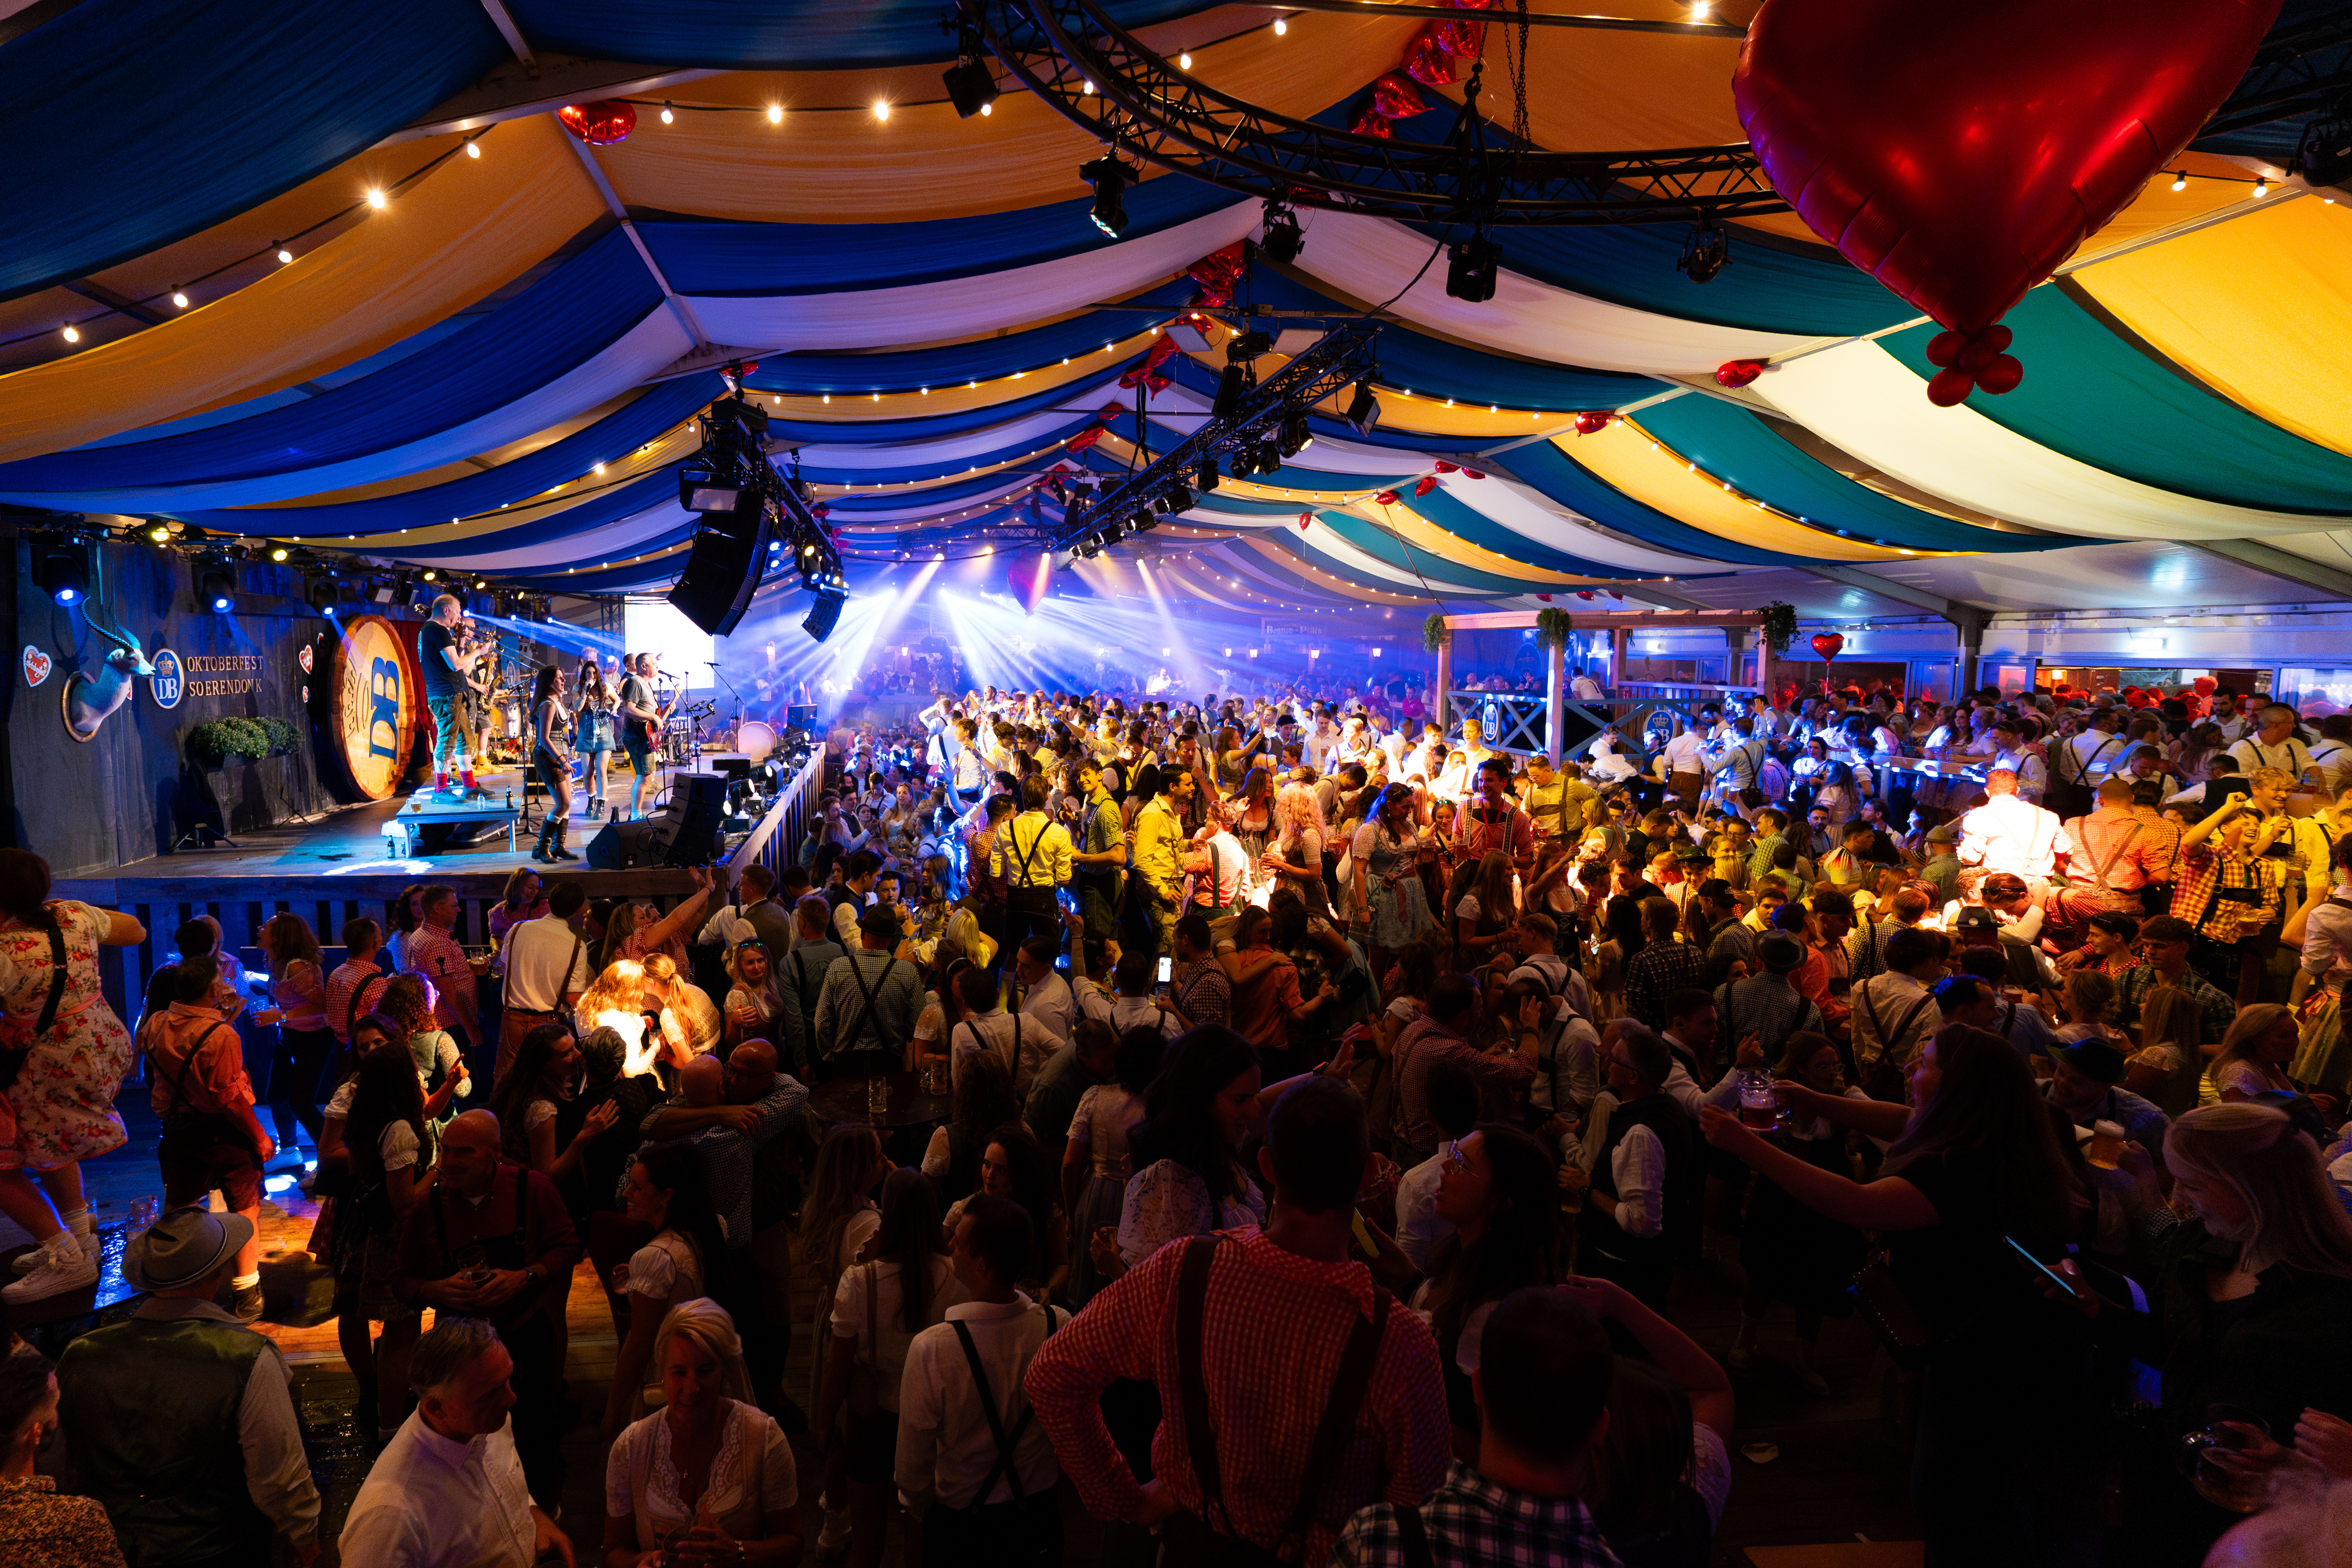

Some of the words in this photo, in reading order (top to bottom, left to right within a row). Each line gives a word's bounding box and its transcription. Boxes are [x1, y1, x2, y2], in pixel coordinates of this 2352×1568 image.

[187, 656, 263, 672] OKTOBERFEST
[158, 678, 178, 699] DB
[189, 678, 262, 697] SOERENDONK
[369, 656, 399, 764] DB
[1486, 722, 1495, 735] DB
